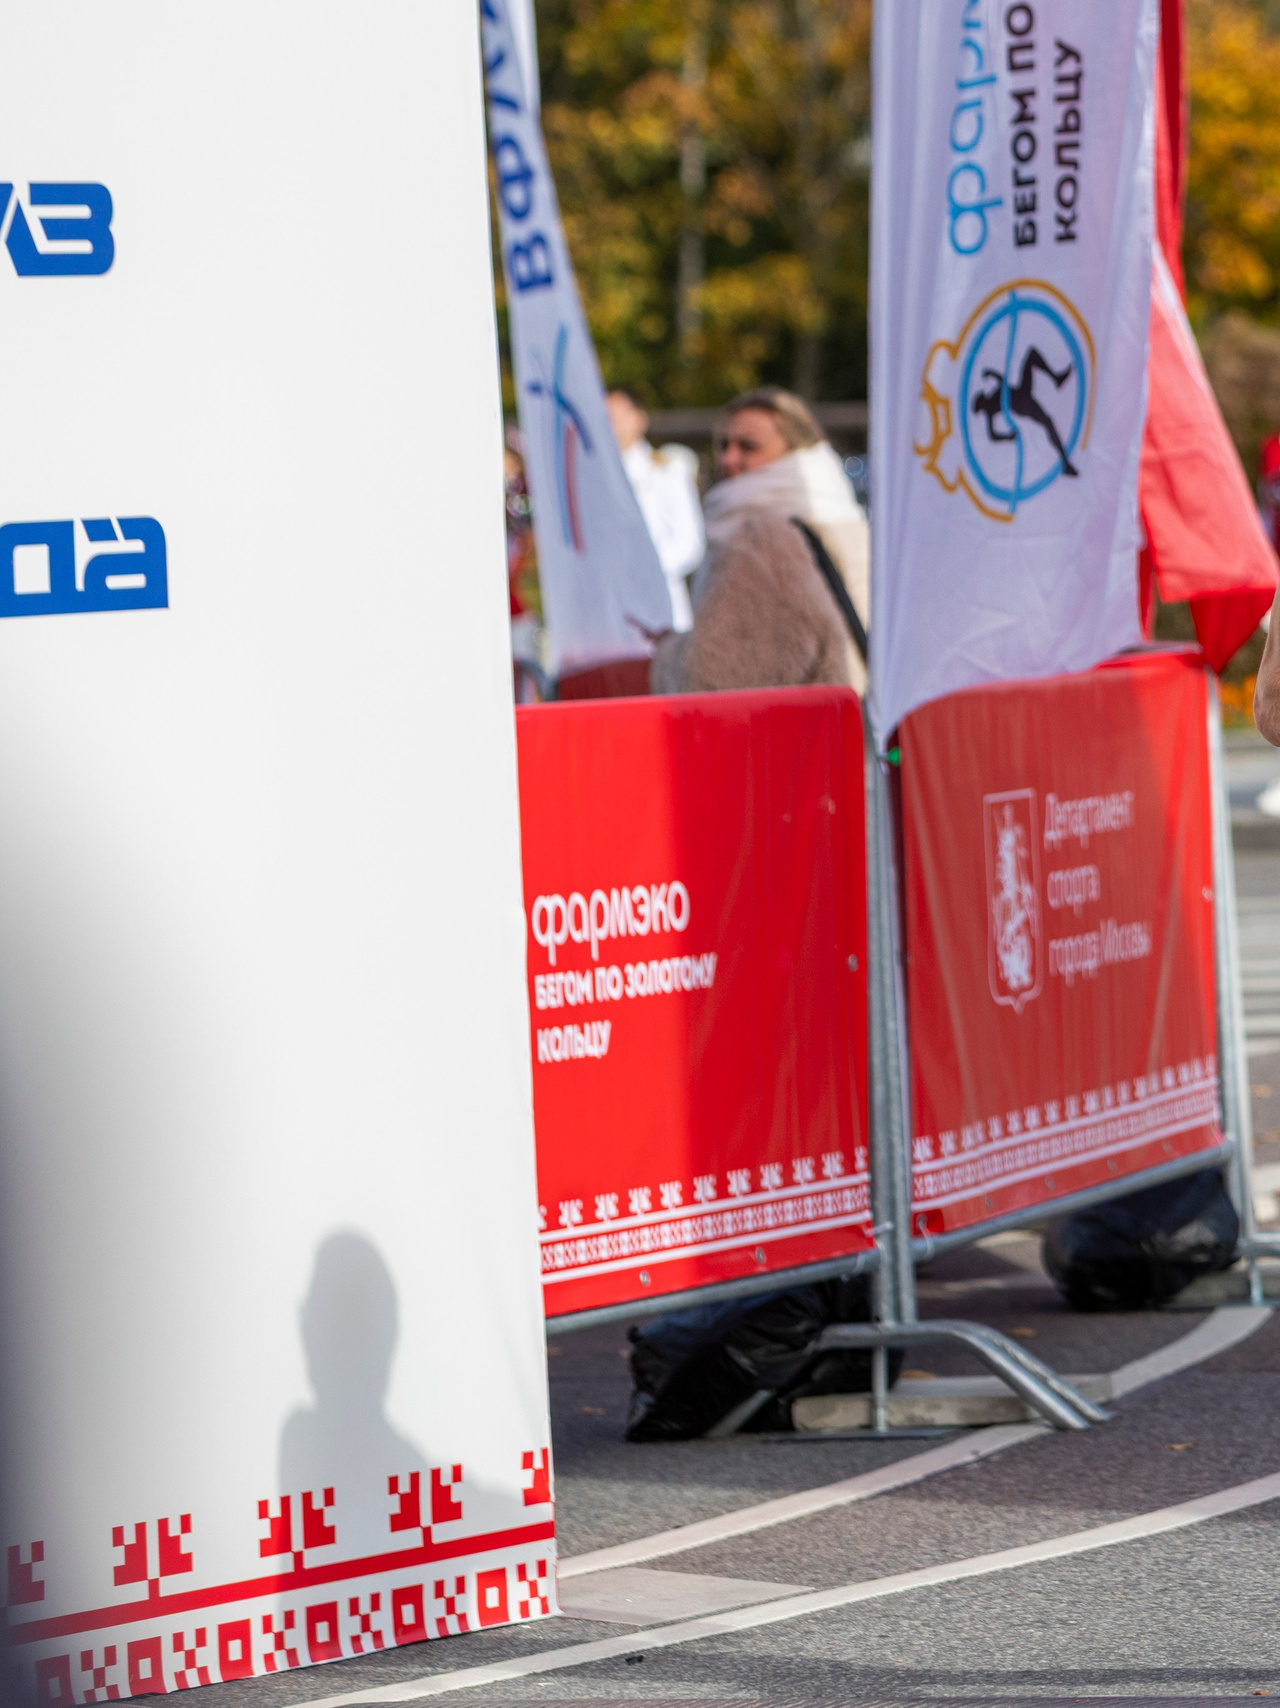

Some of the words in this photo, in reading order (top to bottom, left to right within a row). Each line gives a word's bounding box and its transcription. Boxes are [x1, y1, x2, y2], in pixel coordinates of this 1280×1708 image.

[1004, 2, 1035, 73] ПО
[1009, 88, 1038, 249] БЕГОМ
[1054, 38, 1085, 243] КОЛЬЦУ
[532, 880, 691, 967] фармэко
[534, 968, 593, 1010] БЕГОМ
[594, 965, 624, 1002] ПО
[624, 952, 718, 998] ЗОЛОТОМУ
[536, 1019, 612, 1064] КОЛЬЦУ
